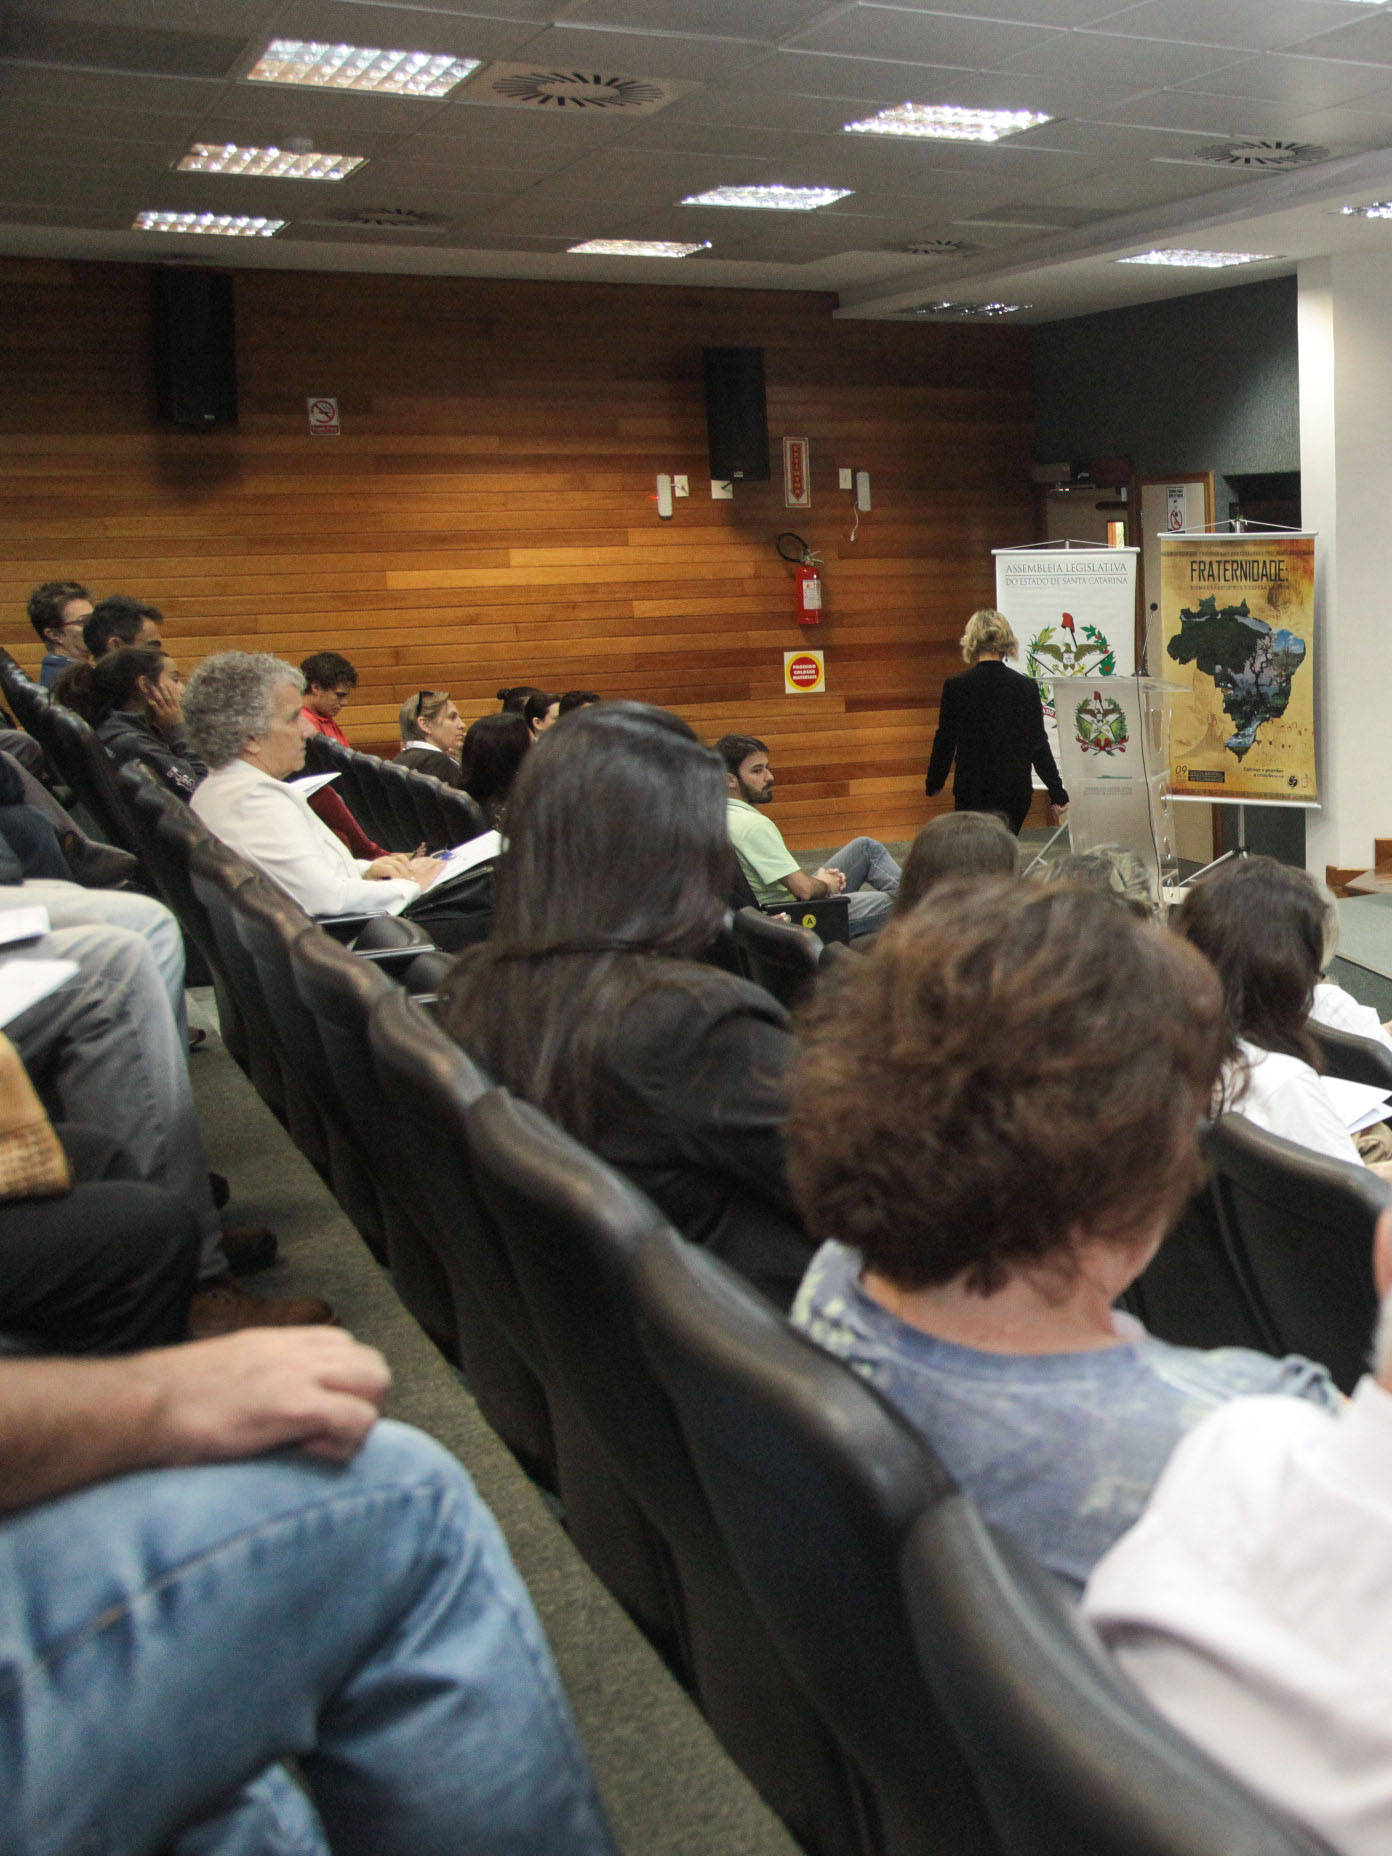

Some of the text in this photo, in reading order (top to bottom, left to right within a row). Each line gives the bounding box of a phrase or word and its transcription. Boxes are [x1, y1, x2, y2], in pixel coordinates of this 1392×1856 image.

[1006, 562, 1128, 573] ASSEMBLEIA LEGISLATIVA
[1190, 559, 1289, 582] FRATERNIDADE:
[1006, 577, 1128, 586] DO ESTADO DE SANTA CATARINA
[1175, 765, 1188, 775] 09
